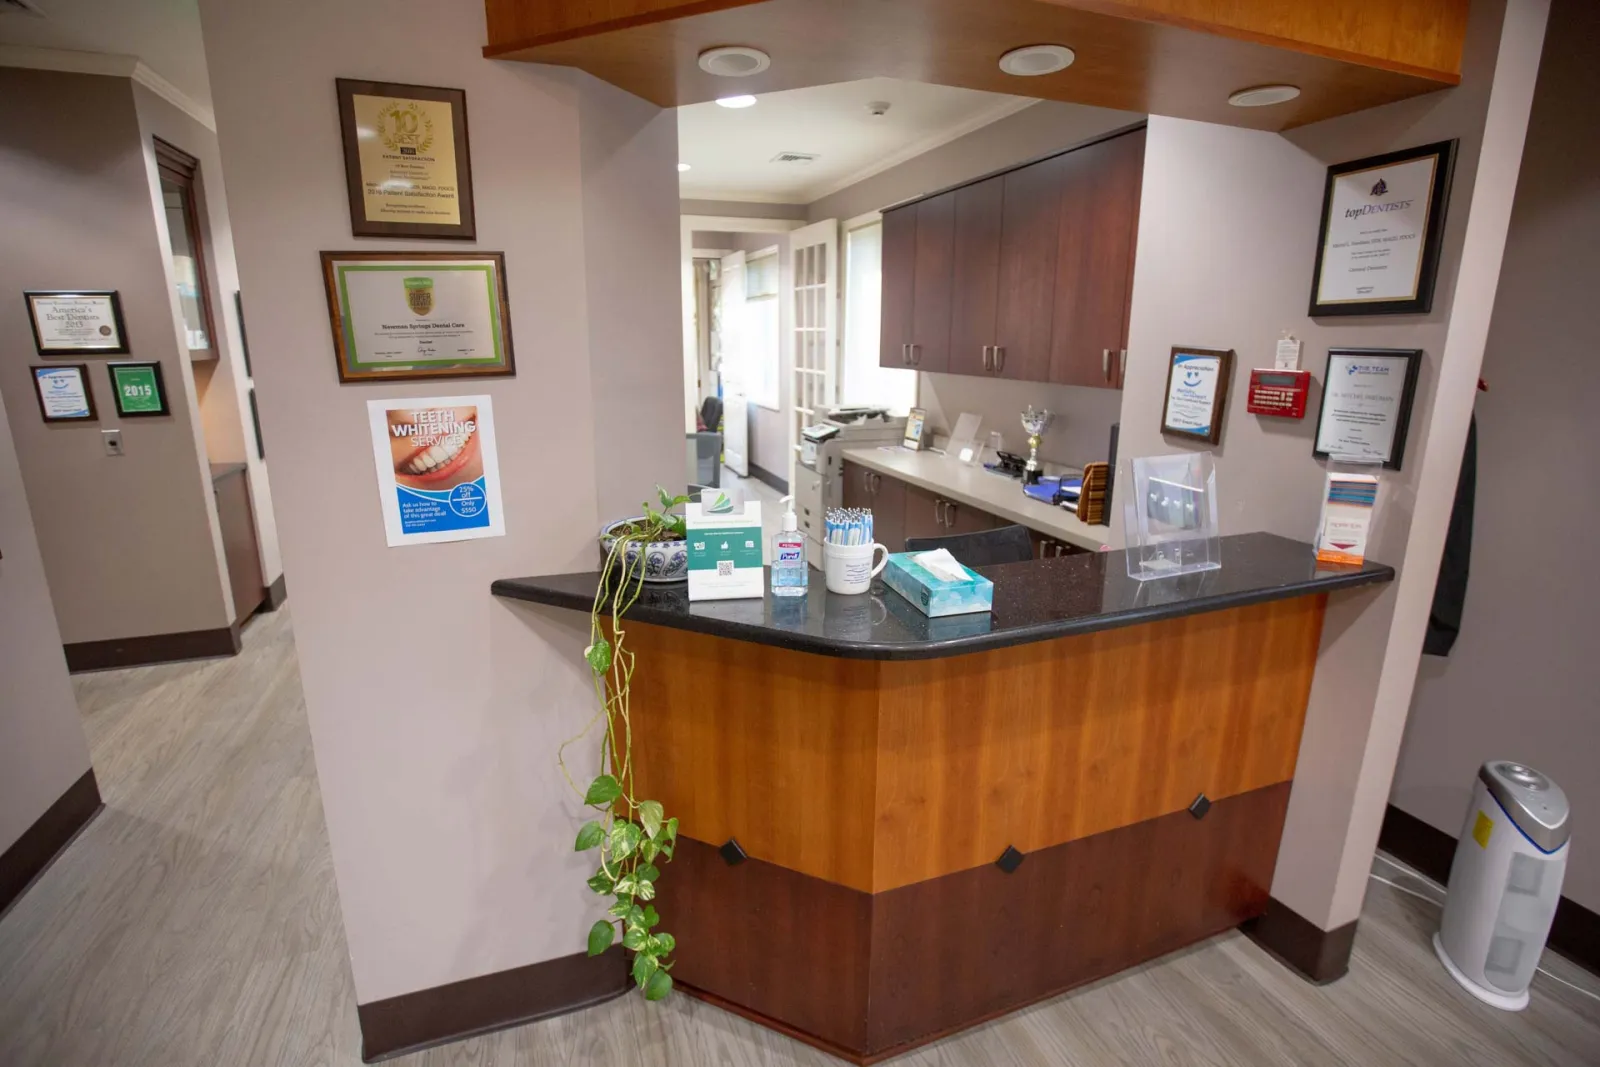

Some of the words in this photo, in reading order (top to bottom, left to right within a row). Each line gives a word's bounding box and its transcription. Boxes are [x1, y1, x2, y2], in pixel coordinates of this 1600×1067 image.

[390, 110, 418, 134] 10
[393, 134, 420, 145] BEST
[404, 190, 436, 198] Satisfaction
[66, 313, 99, 321] Dentists
[124, 385, 152, 396] 2015
[412, 410, 455, 424] TEETH
[391, 421, 476, 437] WHITENING
[411, 433, 464, 447] SERVICE
[461, 500, 475, 508] Only
